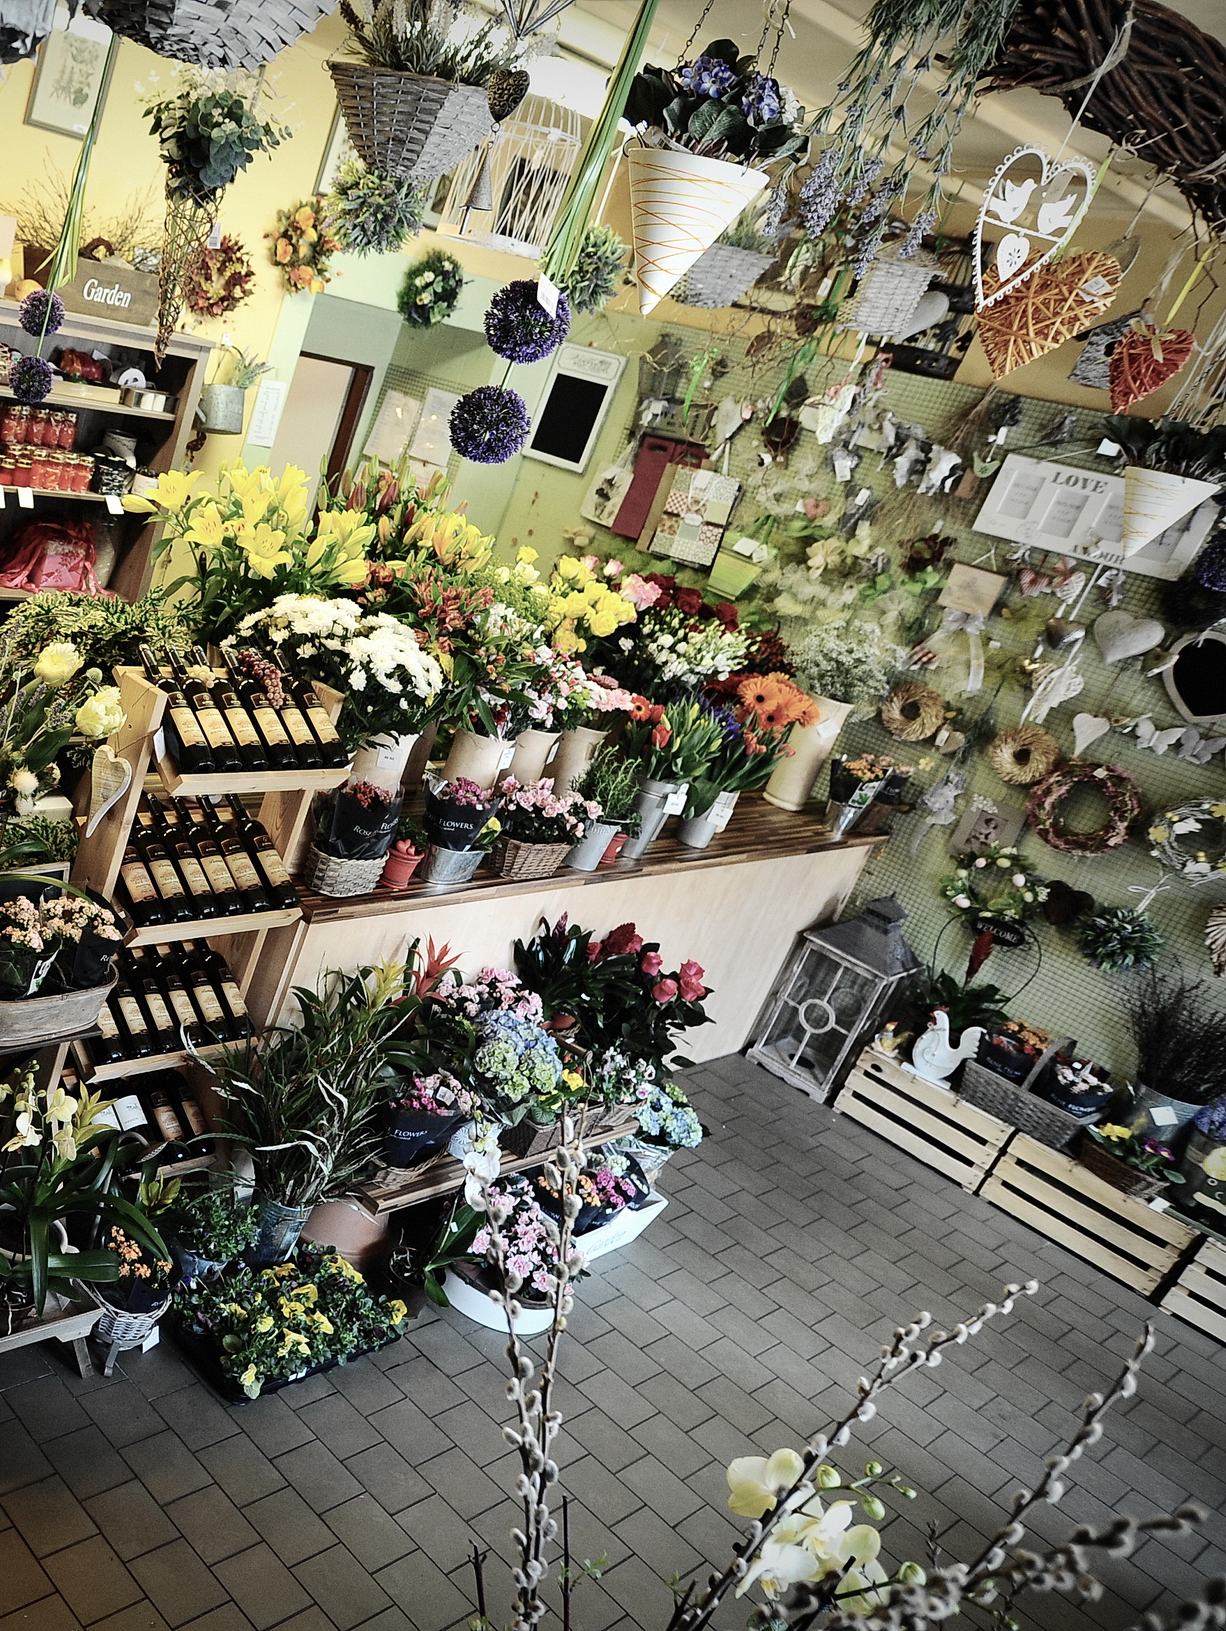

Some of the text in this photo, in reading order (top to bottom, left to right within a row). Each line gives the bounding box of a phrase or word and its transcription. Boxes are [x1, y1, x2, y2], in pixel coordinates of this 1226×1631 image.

[83, 278, 132, 308] Garden
[1050, 471, 1109, 494] LOVE
[977, 921, 1020, 943] WELCOME
